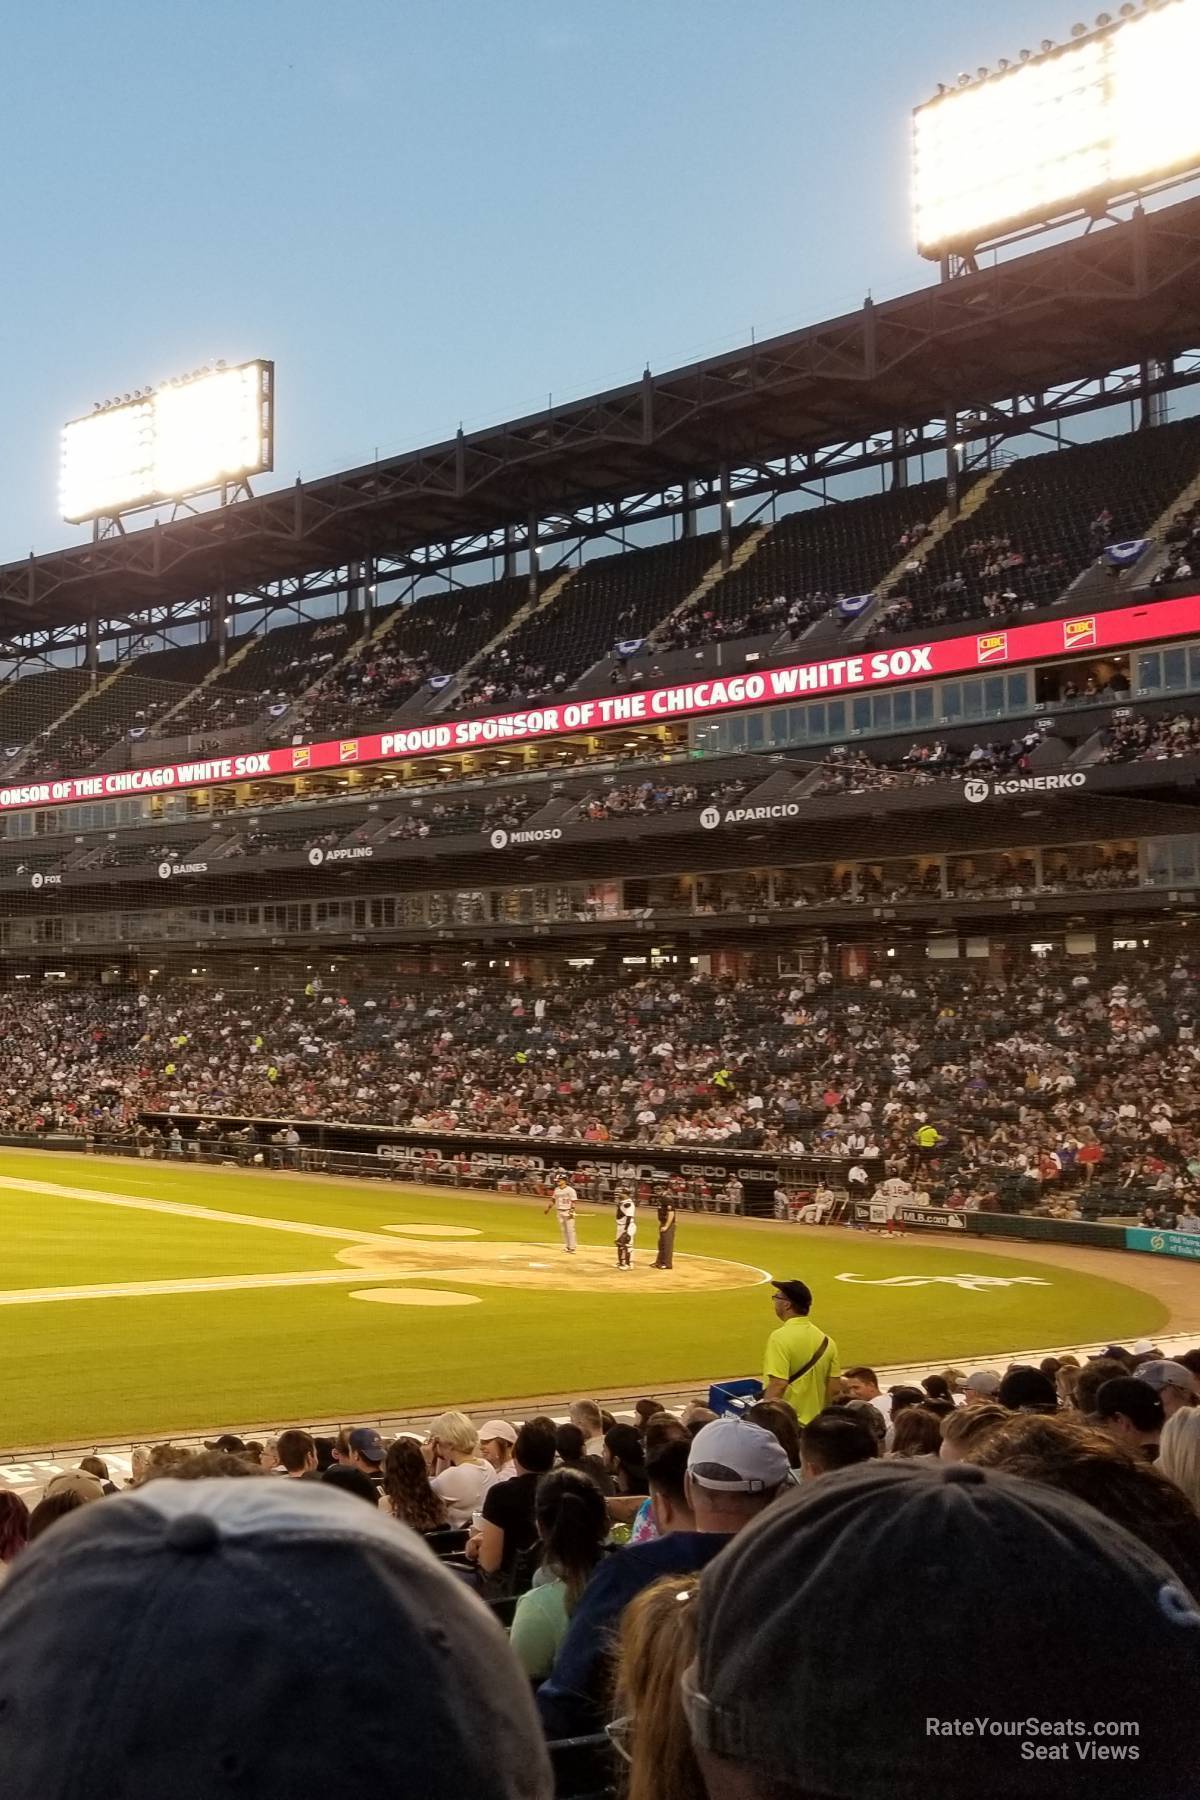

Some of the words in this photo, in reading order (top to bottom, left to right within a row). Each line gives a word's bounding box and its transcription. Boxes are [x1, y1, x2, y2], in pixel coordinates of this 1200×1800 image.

[381, 726, 451, 755] PROUD
[455, 709, 560, 744] SPONSOR
[563, 702, 595, 727] OF
[598, 694, 647, 722] THE
[651, 676, 765, 714] CHICAGO
[770, 658, 865, 695] WHITE
[870, 646, 933, 679] SOX
[52, 782, 73, 799] OF
[74, 777, 104, 796] THE
[105, 766, 175, 793] CHICAGO
[176, 757, 232, 784] WHITE
[234, 753, 272, 774] SOX
[968, 785, 985, 797] 14
[994, 773, 1086, 795] KONERKO
[724, 803, 800, 824] APARICIO
[510, 829, 562, 843] MINOSO
[326, 847, 374, 861] APPLING
[172, 863, 208, 874] BAINES
[44, 875, 62, 884] FOX
[680, 1164, 727, 1178] GEICO
[903, 1211, 948, 1224] MLB.com
